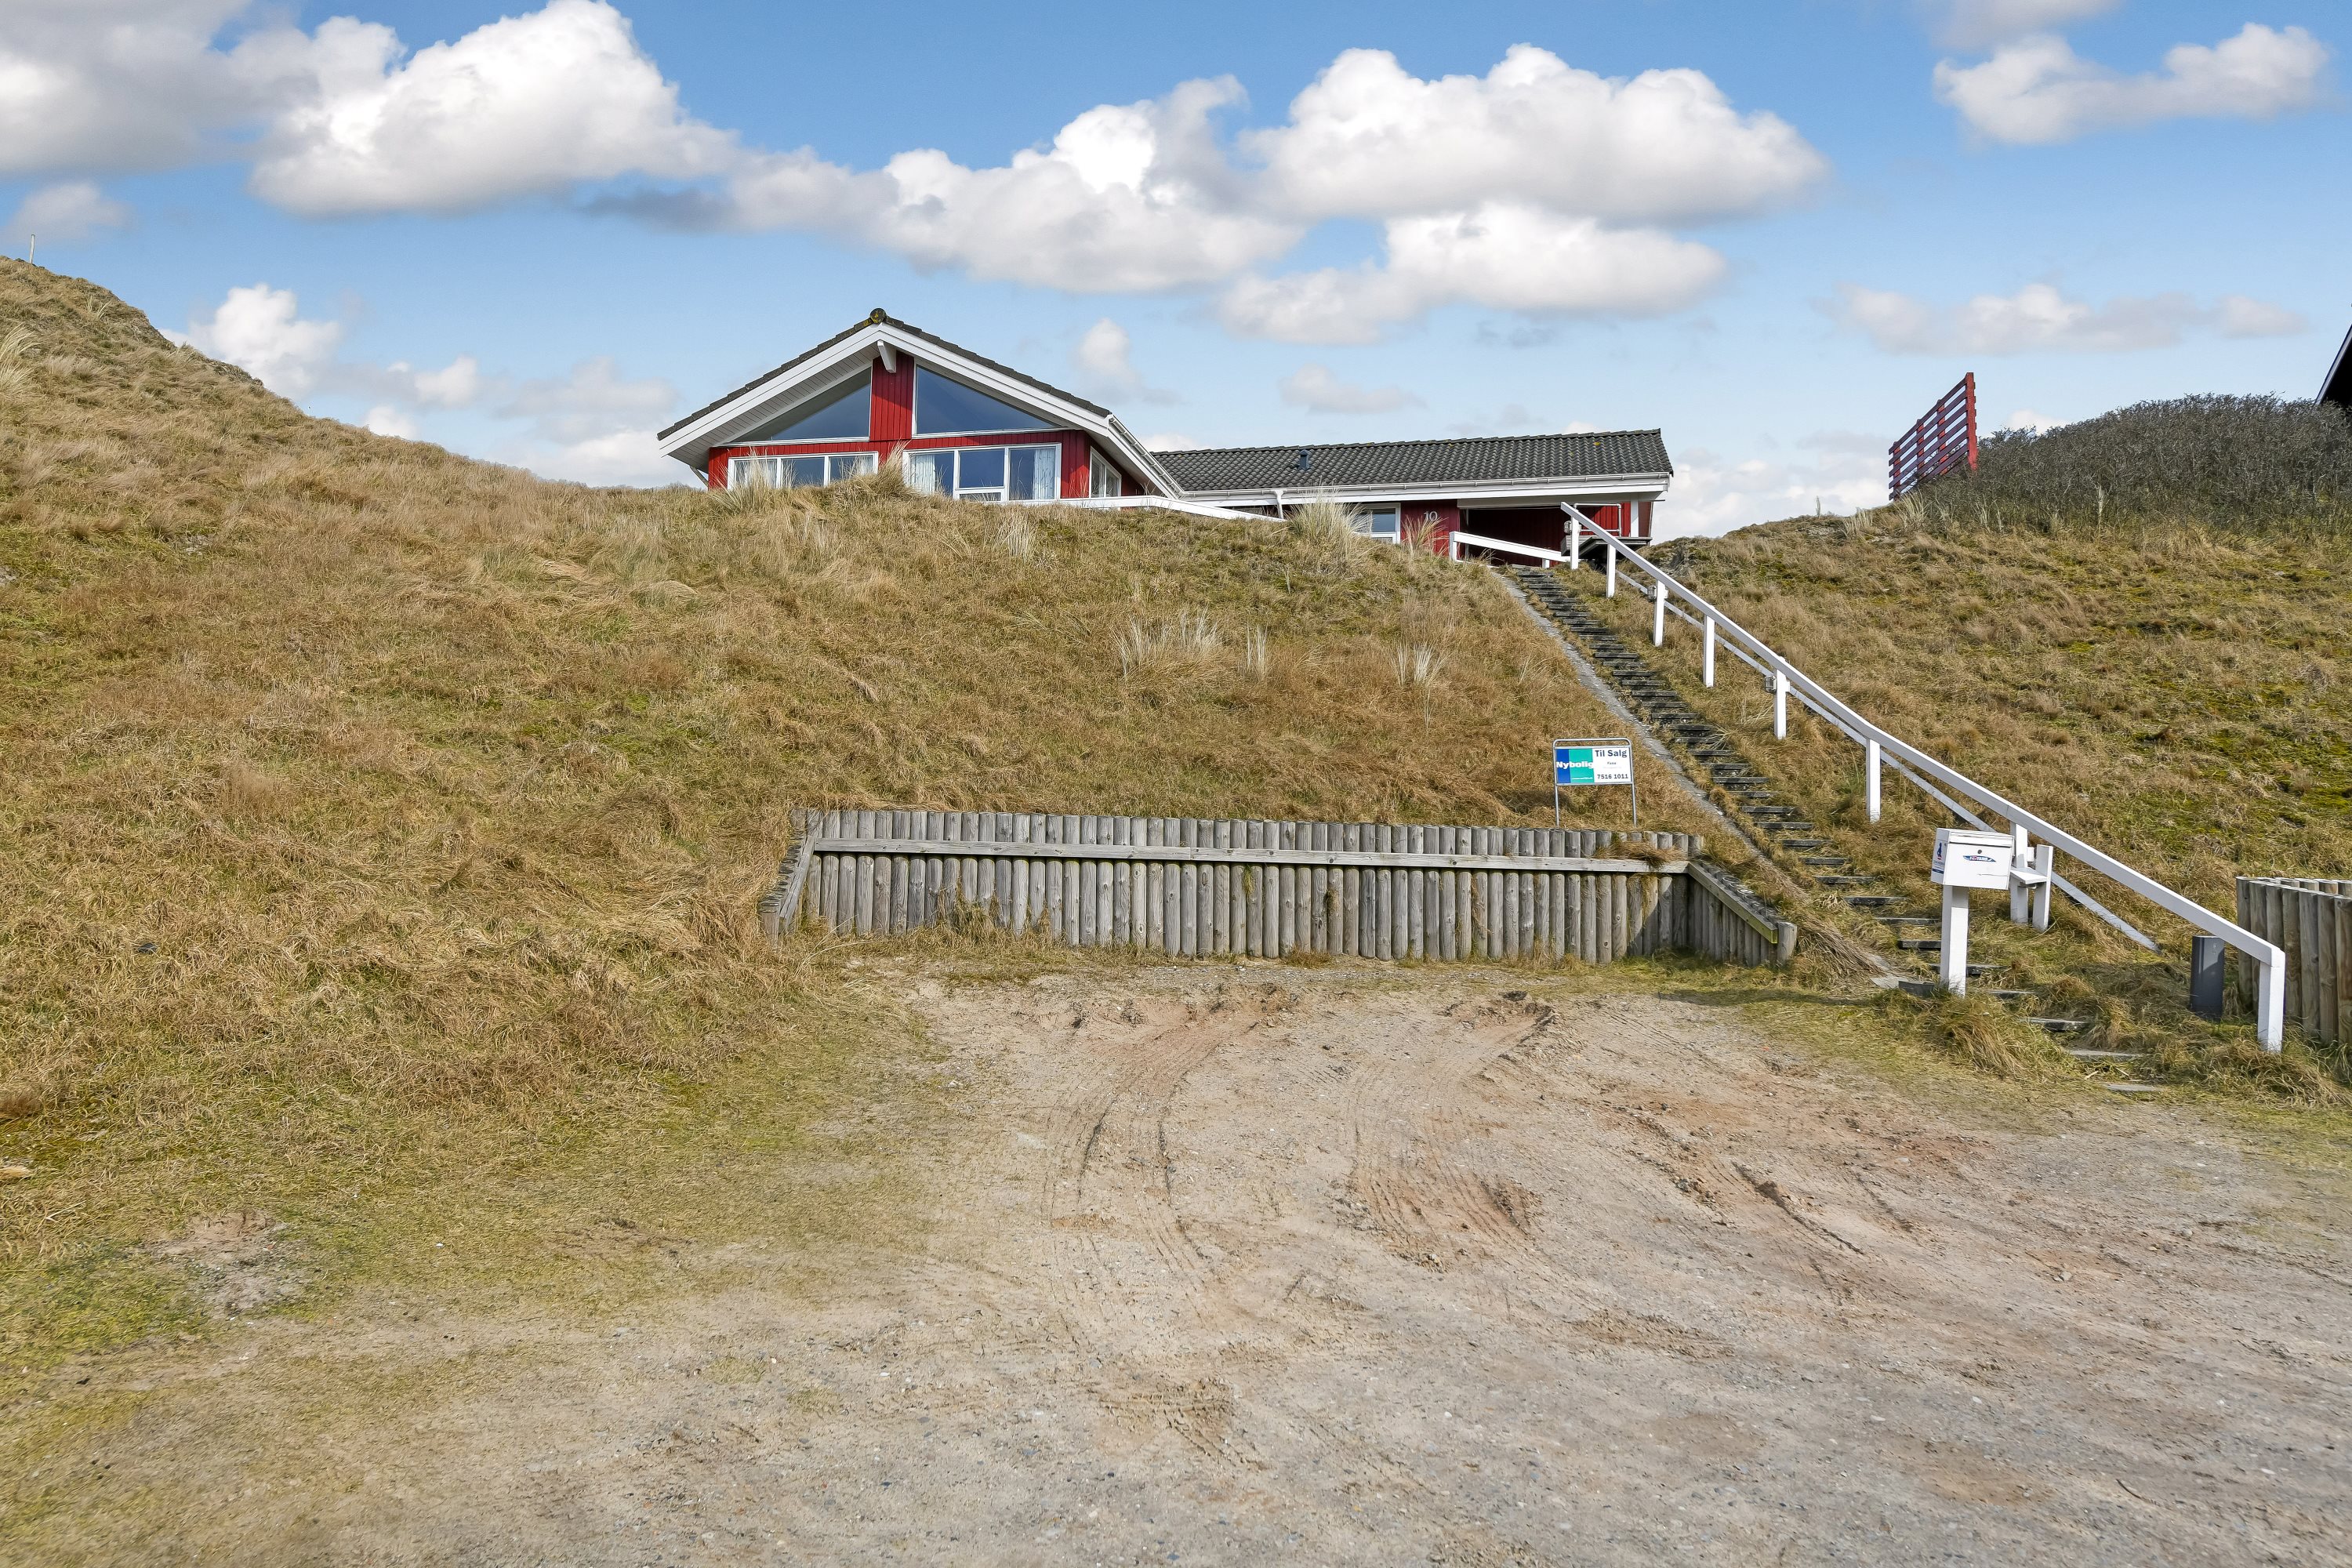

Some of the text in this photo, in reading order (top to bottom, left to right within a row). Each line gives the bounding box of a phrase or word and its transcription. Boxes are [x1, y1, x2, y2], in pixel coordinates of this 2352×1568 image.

[1424, 511, 1438, 521] 10
[1607, 750, 1628, 758] Salg
[1555, 760, 1594, 770] Nybolig
